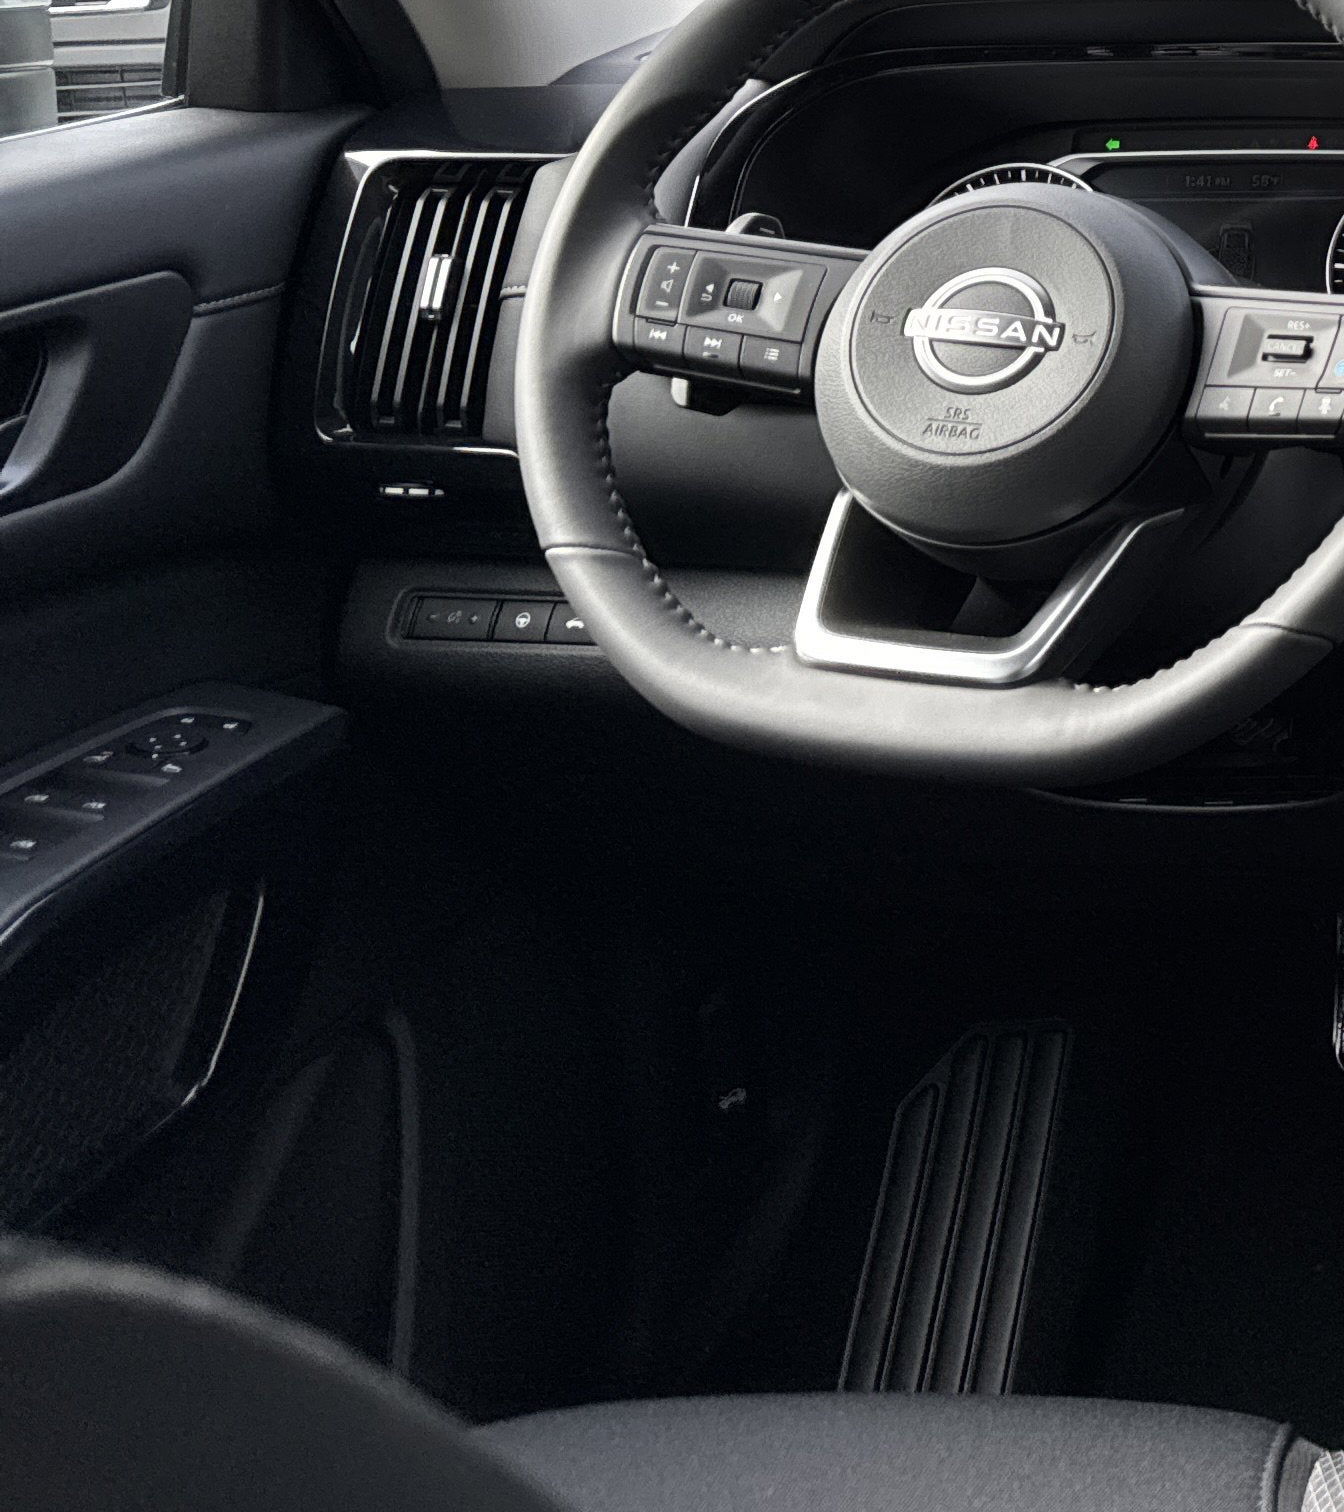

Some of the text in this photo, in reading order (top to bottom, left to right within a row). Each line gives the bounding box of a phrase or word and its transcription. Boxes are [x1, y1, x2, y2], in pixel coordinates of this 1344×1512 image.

[728, 313, 744, 323] OK
[908, 312, 1061, 347] NISSAN
[944, 406, 971, 420] SRS
[922, 422, 982, 439] AIRBAG
